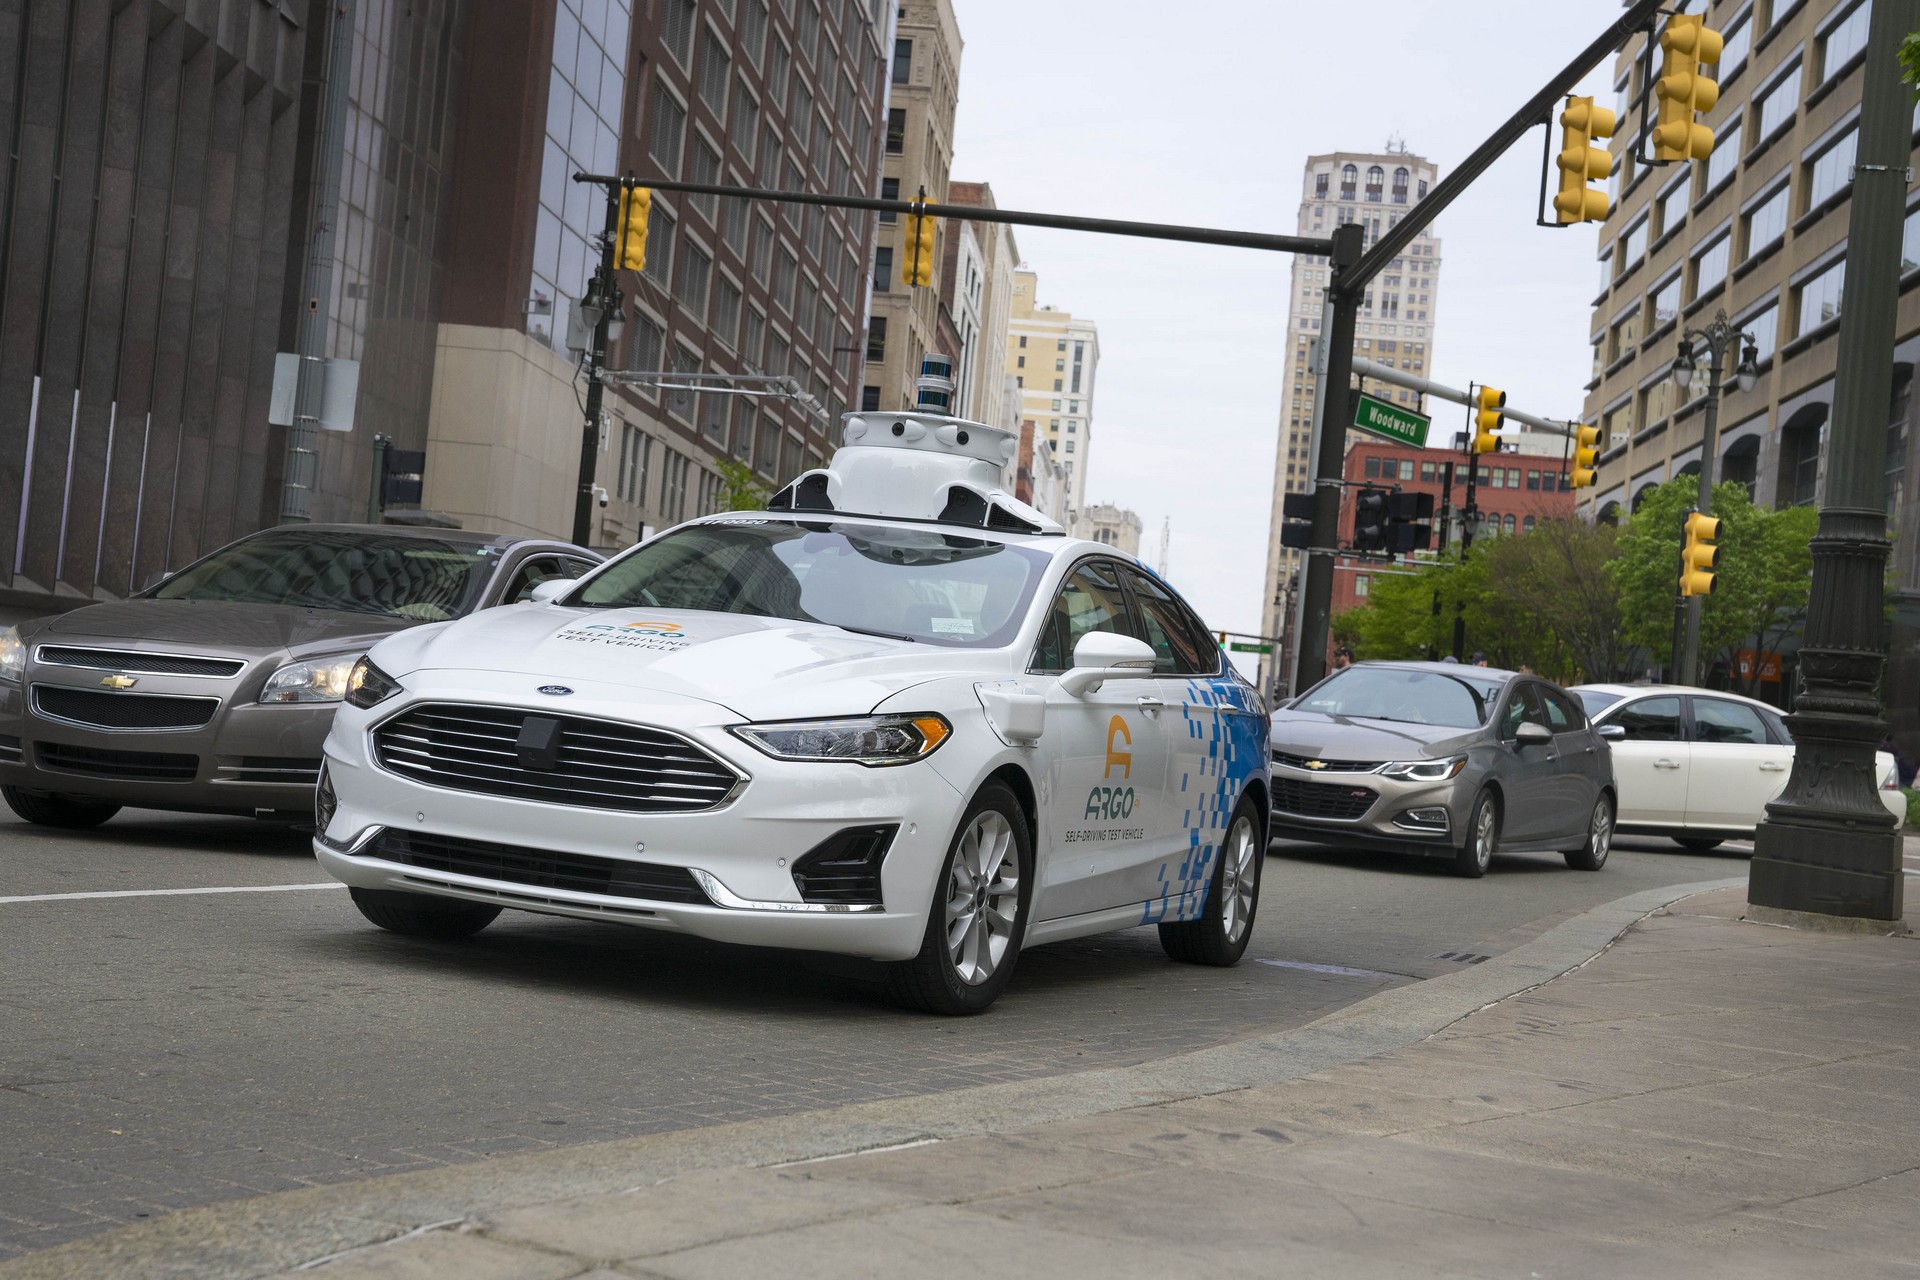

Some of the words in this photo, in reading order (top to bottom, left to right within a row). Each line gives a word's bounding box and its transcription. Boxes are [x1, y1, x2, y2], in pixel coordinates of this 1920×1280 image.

[1368, 406, 1417, 437] Woodward
[563, 629, 692, 647] SELF-DRIVING
[585, 624, 685, 638] ARGO
[556, 633, 601, 643] TEST
[605, 639, 681, 652] VEHICLE
[540, 686, 569, 695] Ford
[1084, 786, 1135, 820] ARGO
[1064, 830, 1107, 843] SELF-DRIVING
[1107, 829, 1122, 841] TEST
[1122, 828, 1144, 840] VEHICLE
